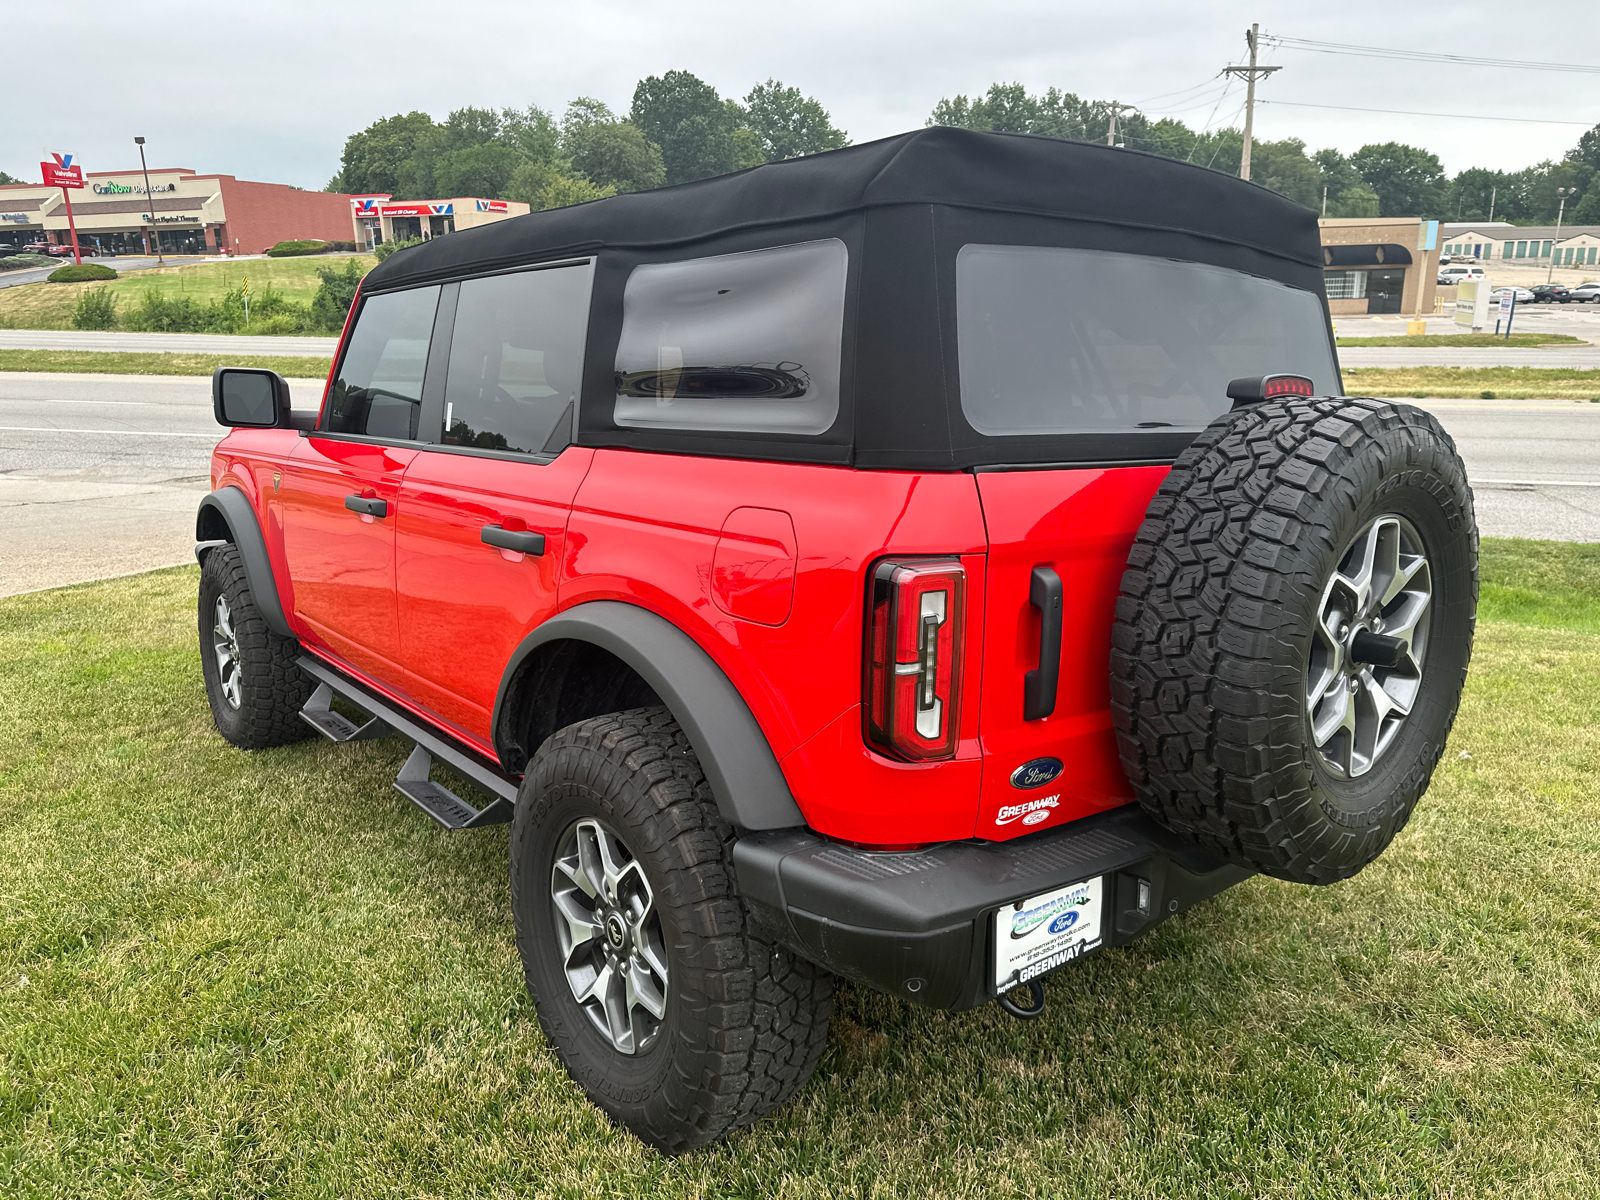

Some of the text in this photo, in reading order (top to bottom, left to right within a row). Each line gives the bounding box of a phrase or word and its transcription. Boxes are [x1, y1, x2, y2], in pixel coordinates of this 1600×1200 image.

[53, 169, 78, 178] Valvoline
[1024, 767, 1054, 785] Ford
[998, 794, 1061, 820] GREENWAY
[1012, 885, 1090, 931] GREENWAY
[1053, 914, 1073, 932] Ford
[1020, 943, 1082, 983] GREENWAY
